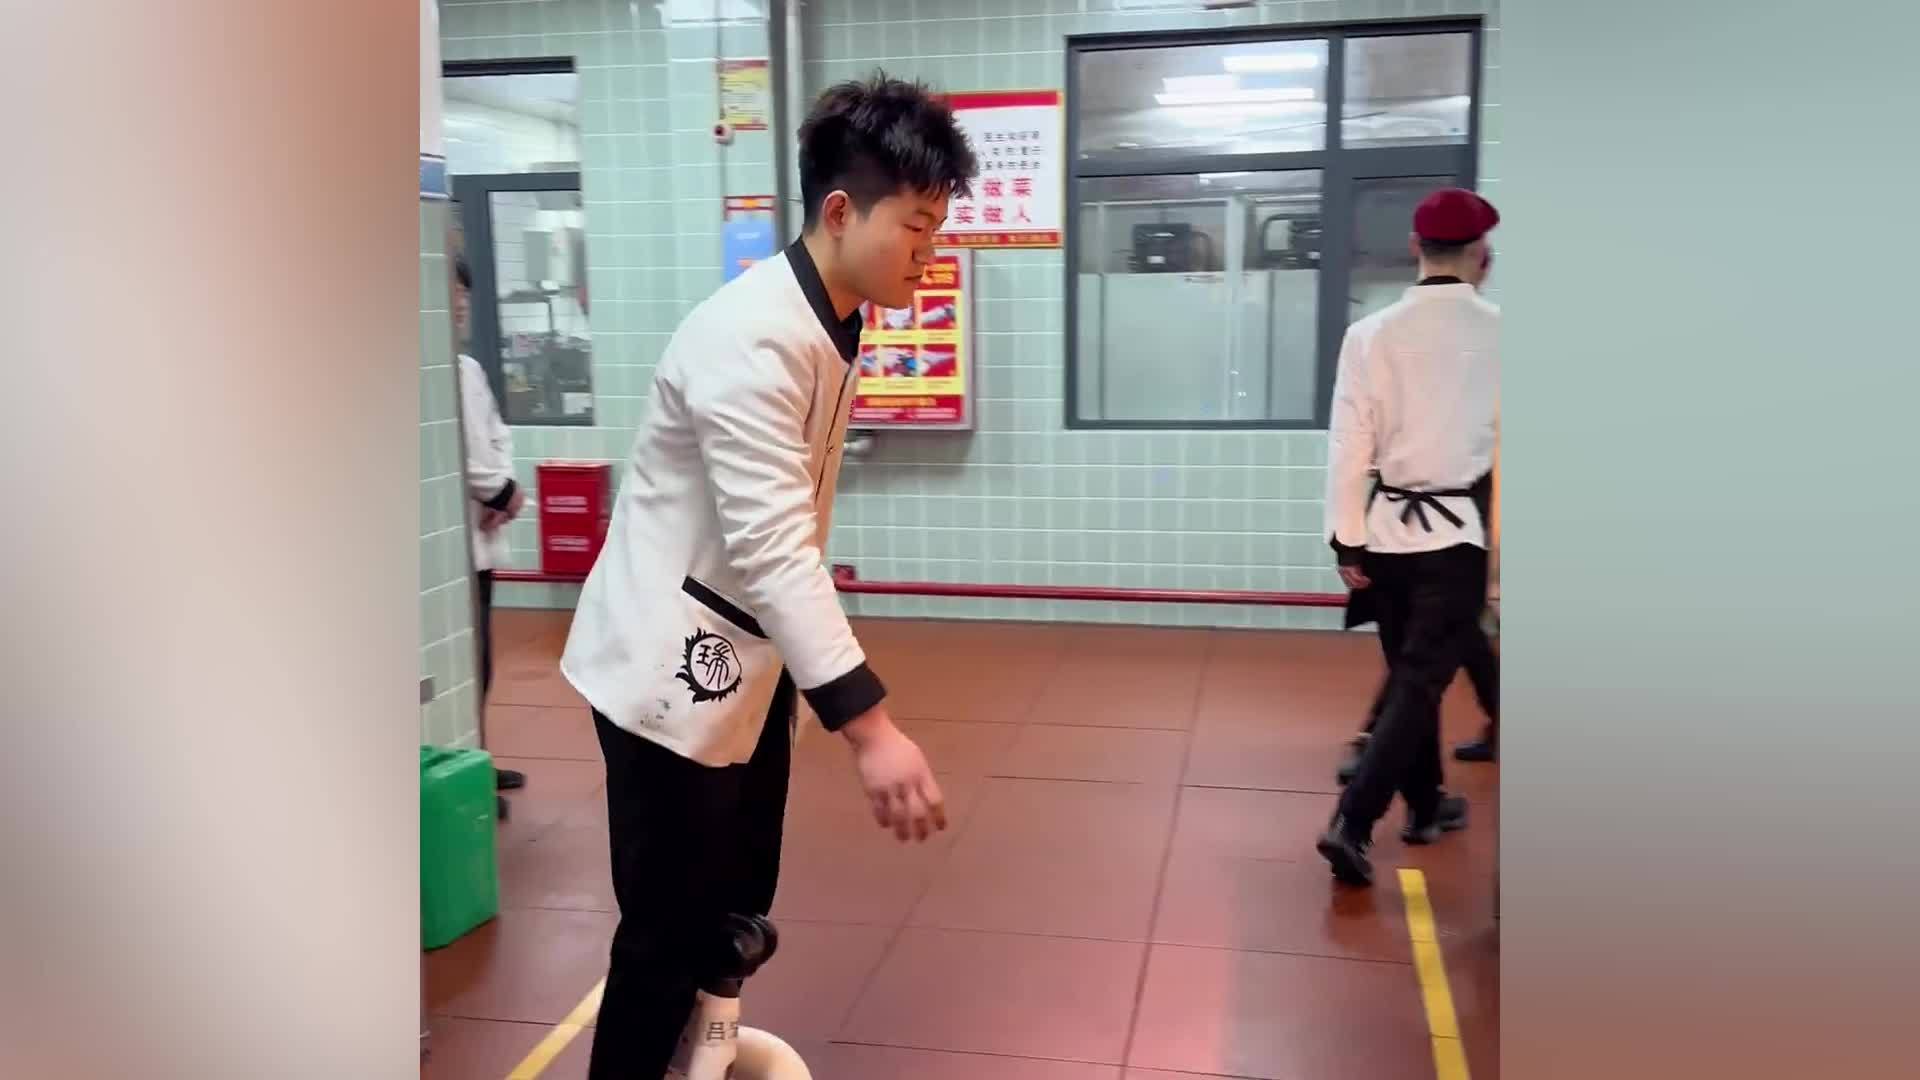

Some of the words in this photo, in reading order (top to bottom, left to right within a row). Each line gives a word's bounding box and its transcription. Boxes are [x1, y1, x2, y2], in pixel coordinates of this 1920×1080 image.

[966, 177, 1033, 197] 做菜
[954, 204, 1032, 224] 实做人
[696, 641, 731, 690] 瑞
